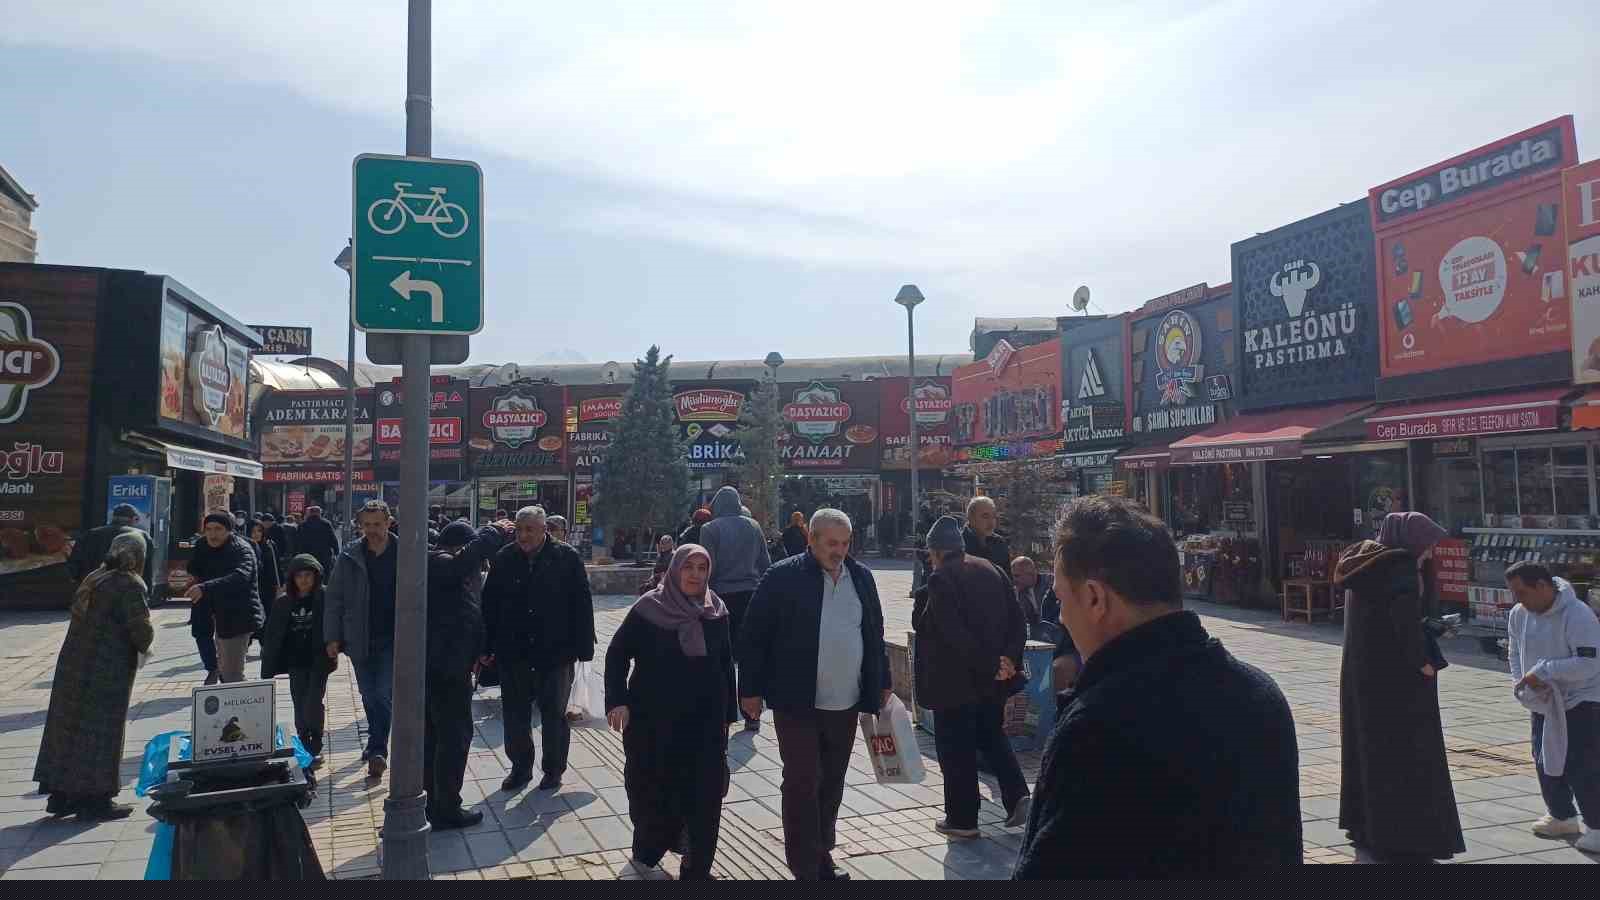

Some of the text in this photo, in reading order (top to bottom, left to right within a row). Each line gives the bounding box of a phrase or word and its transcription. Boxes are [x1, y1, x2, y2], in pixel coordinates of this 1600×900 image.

[1380, 138, 1549, 213] Cep Burada
[1244, 302, 1356, 352] KALEÖNÜ
[1255, 338, 1346, 369] PASTIRMA
[291, 399, 344, 408] PASTIRMACI
[265, 409, 306, 420] ADEM
[1063, 424, 1089, 441] AKYÜZ
[1377, 424, 1395, 439] Cep
[1399, 420, 1437, 436] Burada
[688, 441, 745, 458] BRİKA
[782, 445, 856, 458] KANAAT
[112, 484, 148, 497] Erikli
